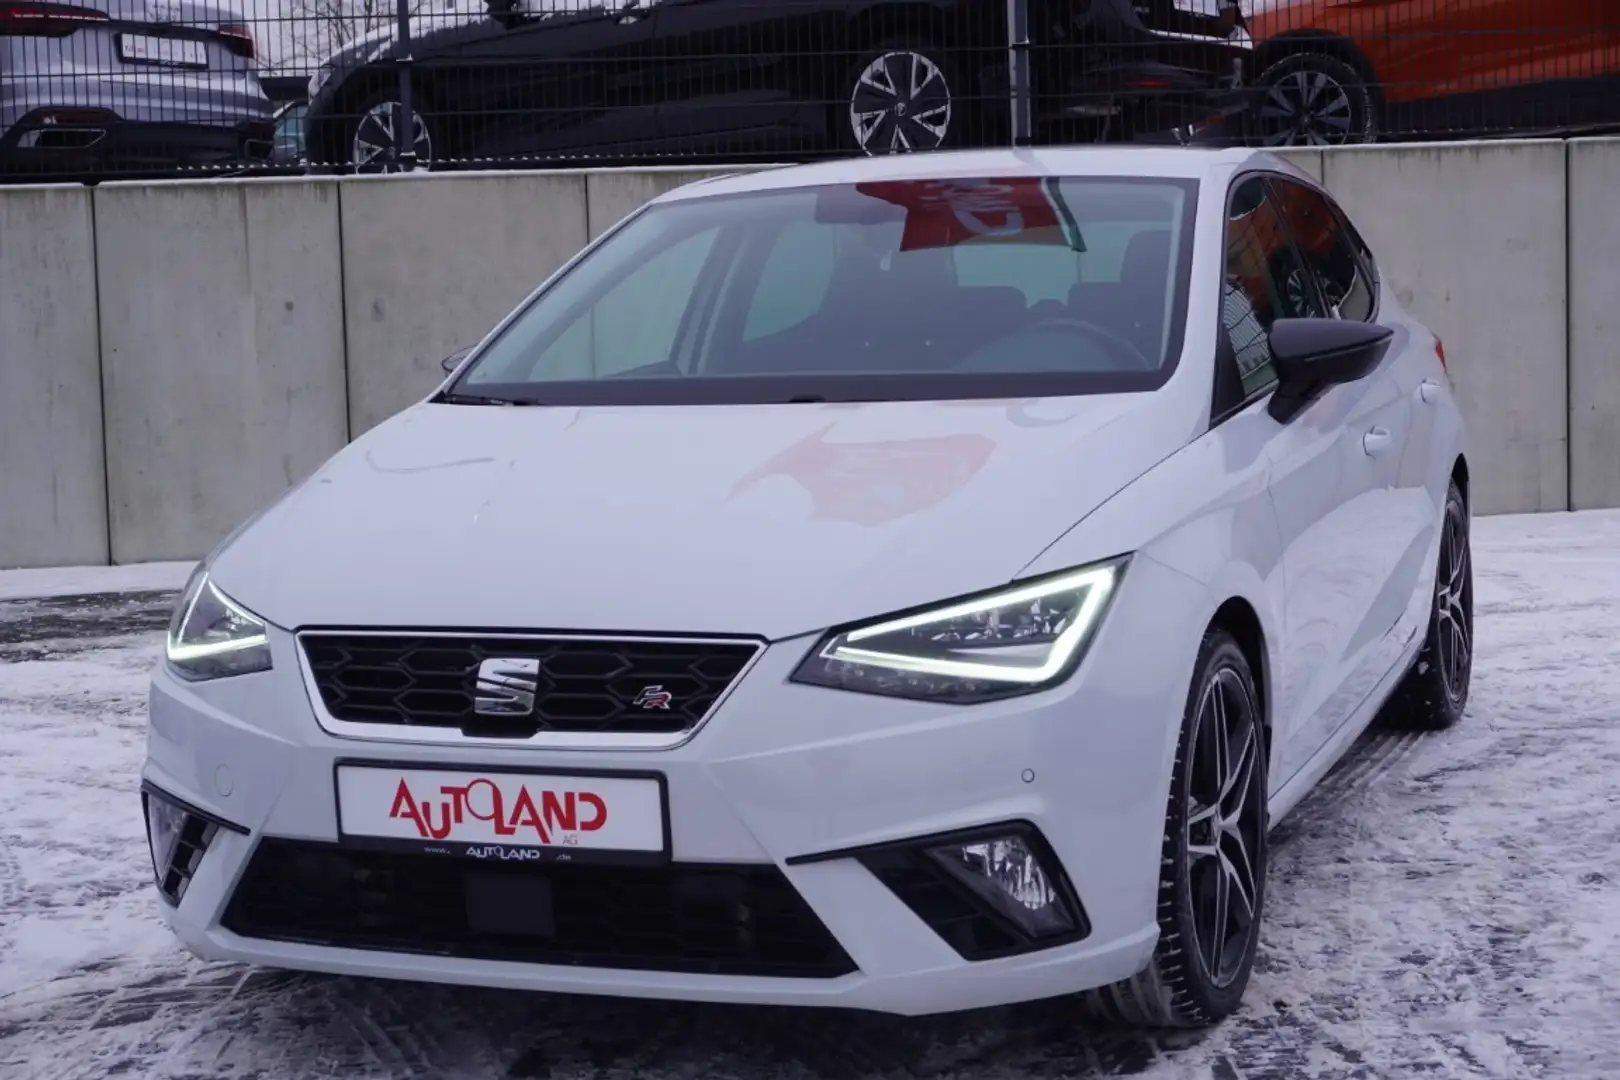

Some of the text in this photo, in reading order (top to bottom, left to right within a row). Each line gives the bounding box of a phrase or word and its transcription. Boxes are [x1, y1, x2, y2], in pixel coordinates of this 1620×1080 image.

[632, 685, 673, 710] FR
[389, 777, 608, 845] AUTOLAND
[562, 834, 578, 846] AG
[466, 846, 541, 861] AUTOLAND
